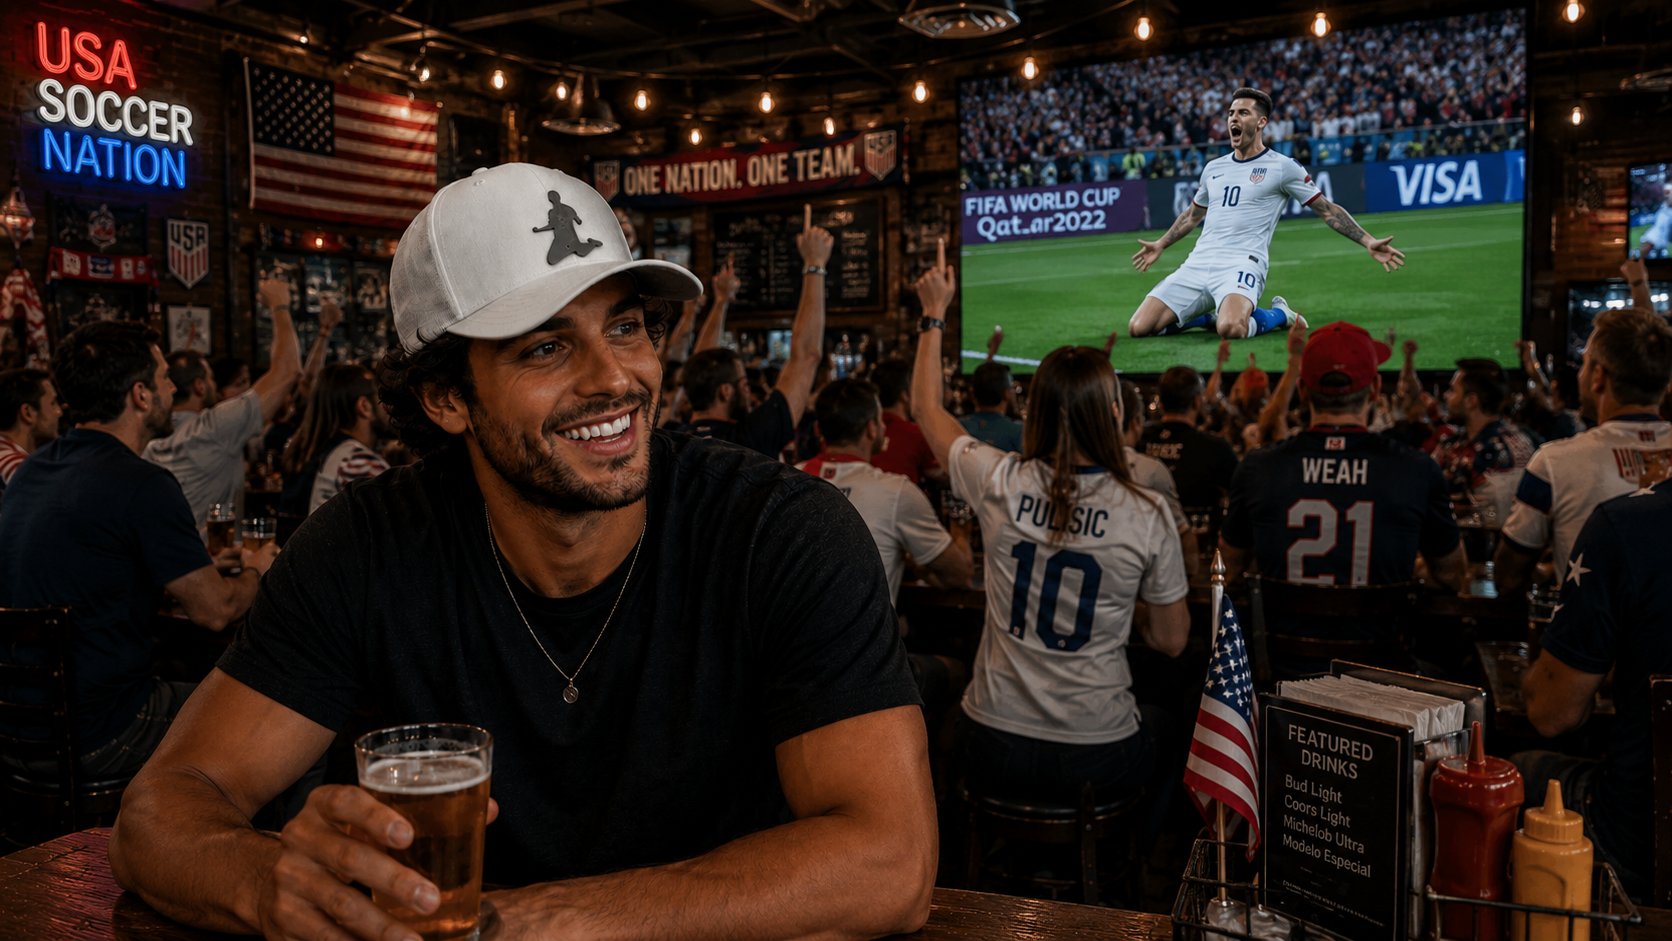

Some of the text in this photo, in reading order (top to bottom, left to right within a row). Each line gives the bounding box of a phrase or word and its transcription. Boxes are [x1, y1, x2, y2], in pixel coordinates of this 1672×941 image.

[36, 21, 138, 90] USA
[38, 78, 194, 146] SOCCER
[43, 128, 186, 189] NATION
[624, 164, 661, 196] ONE
[665, 158, 743, 194] NATION.
[747, 153, 789, 187] ONE
[793, 143, 861, 182] TEAM.
[965, 187, 1121, 216] FIFA WORLD CUP
[1222, 185, 1241, 207] 10
[1389, 159, 1483, 206] VISA
[170, 222, 207, 252] USA
[1237, 271, 1256, 288] 10
[1302, 457, 1368, 485] WEAH
[1016, 494, 1109, 538] PULSIC
[1287, 498, 1374, 586] 21
[1009, 540, 1103, 652] 10
[1288, 723, 1374, 761] FEATURED
[1301, 749, 1358, 780] DRINKS
[1285, 774, 1342, 804] Bud Light
[1284, 794, 1351, 828] Coors Light
[1283, 814, 1365, 854] Michelob Ultra
[1282, 833, 1321, 858] Modelo
[1324, 849, 1371, 878] Especial
